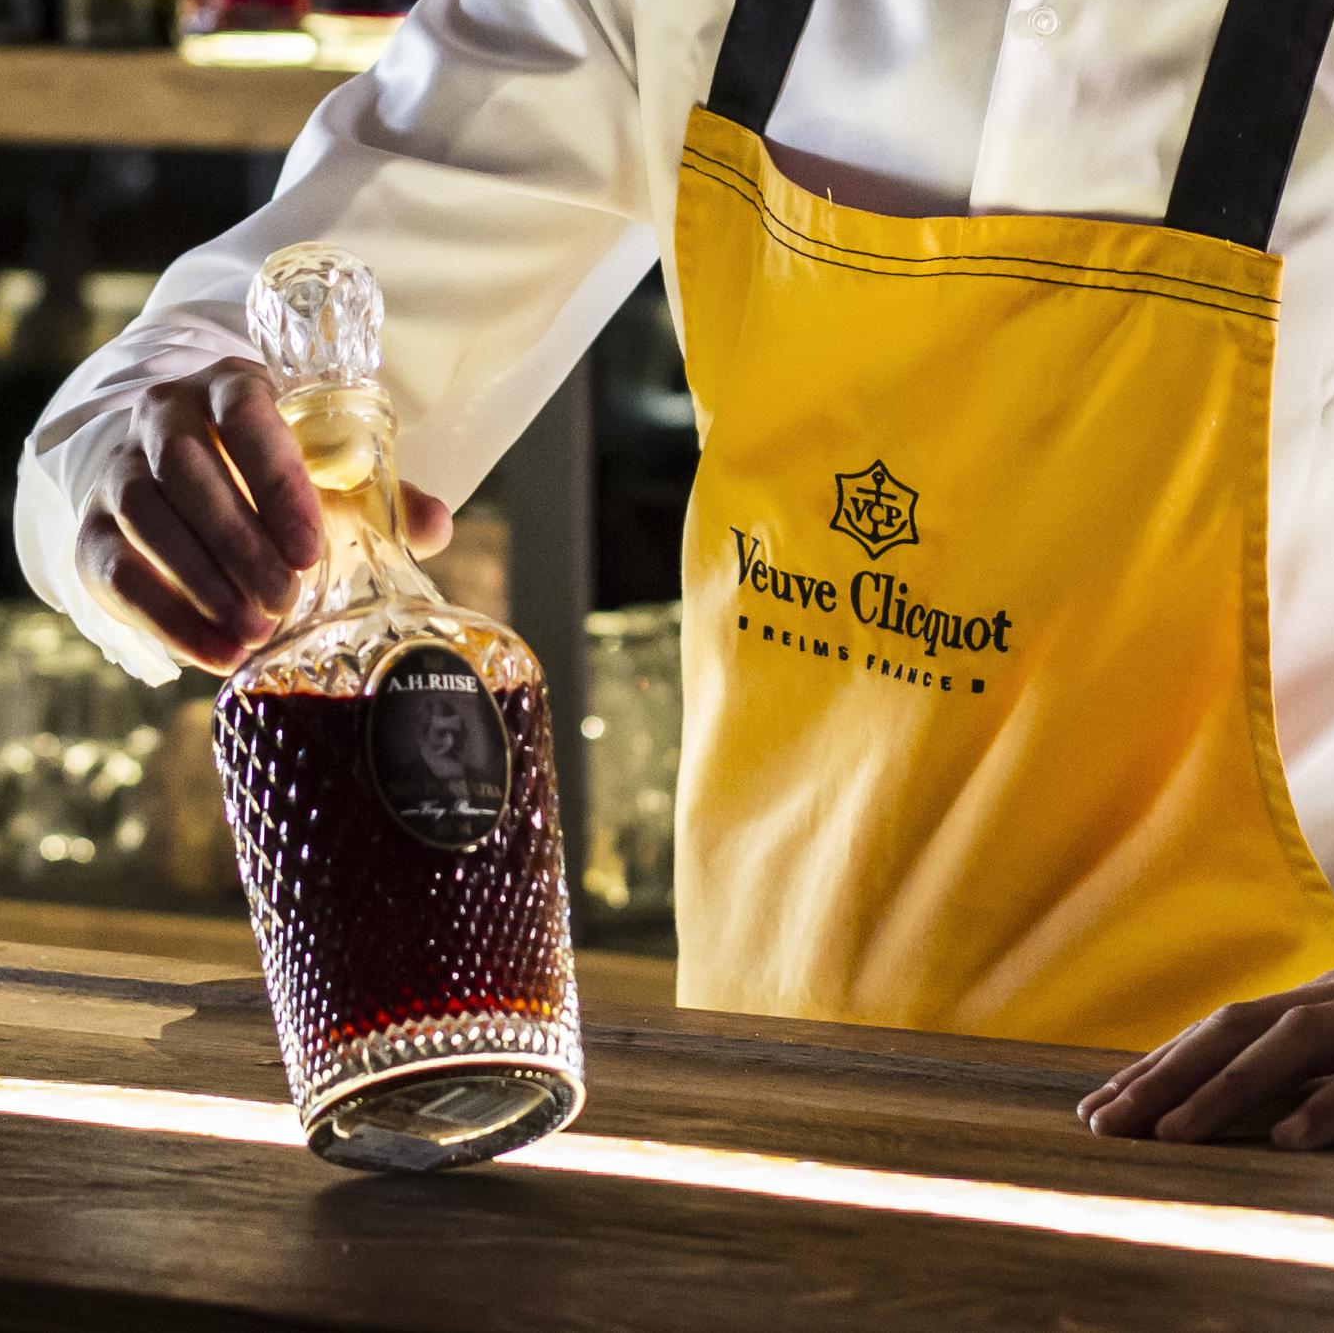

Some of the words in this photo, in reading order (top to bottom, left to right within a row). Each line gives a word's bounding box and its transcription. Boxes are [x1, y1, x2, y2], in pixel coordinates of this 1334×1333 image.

[850, 497, 902, 528] VCP
[730, 526, 837, 613] Veuve
[850, 570, 1012, 656] Clicquot
[763, 625, 849, 661] REIMS
[867, 654, 952, 692] FRANCE
